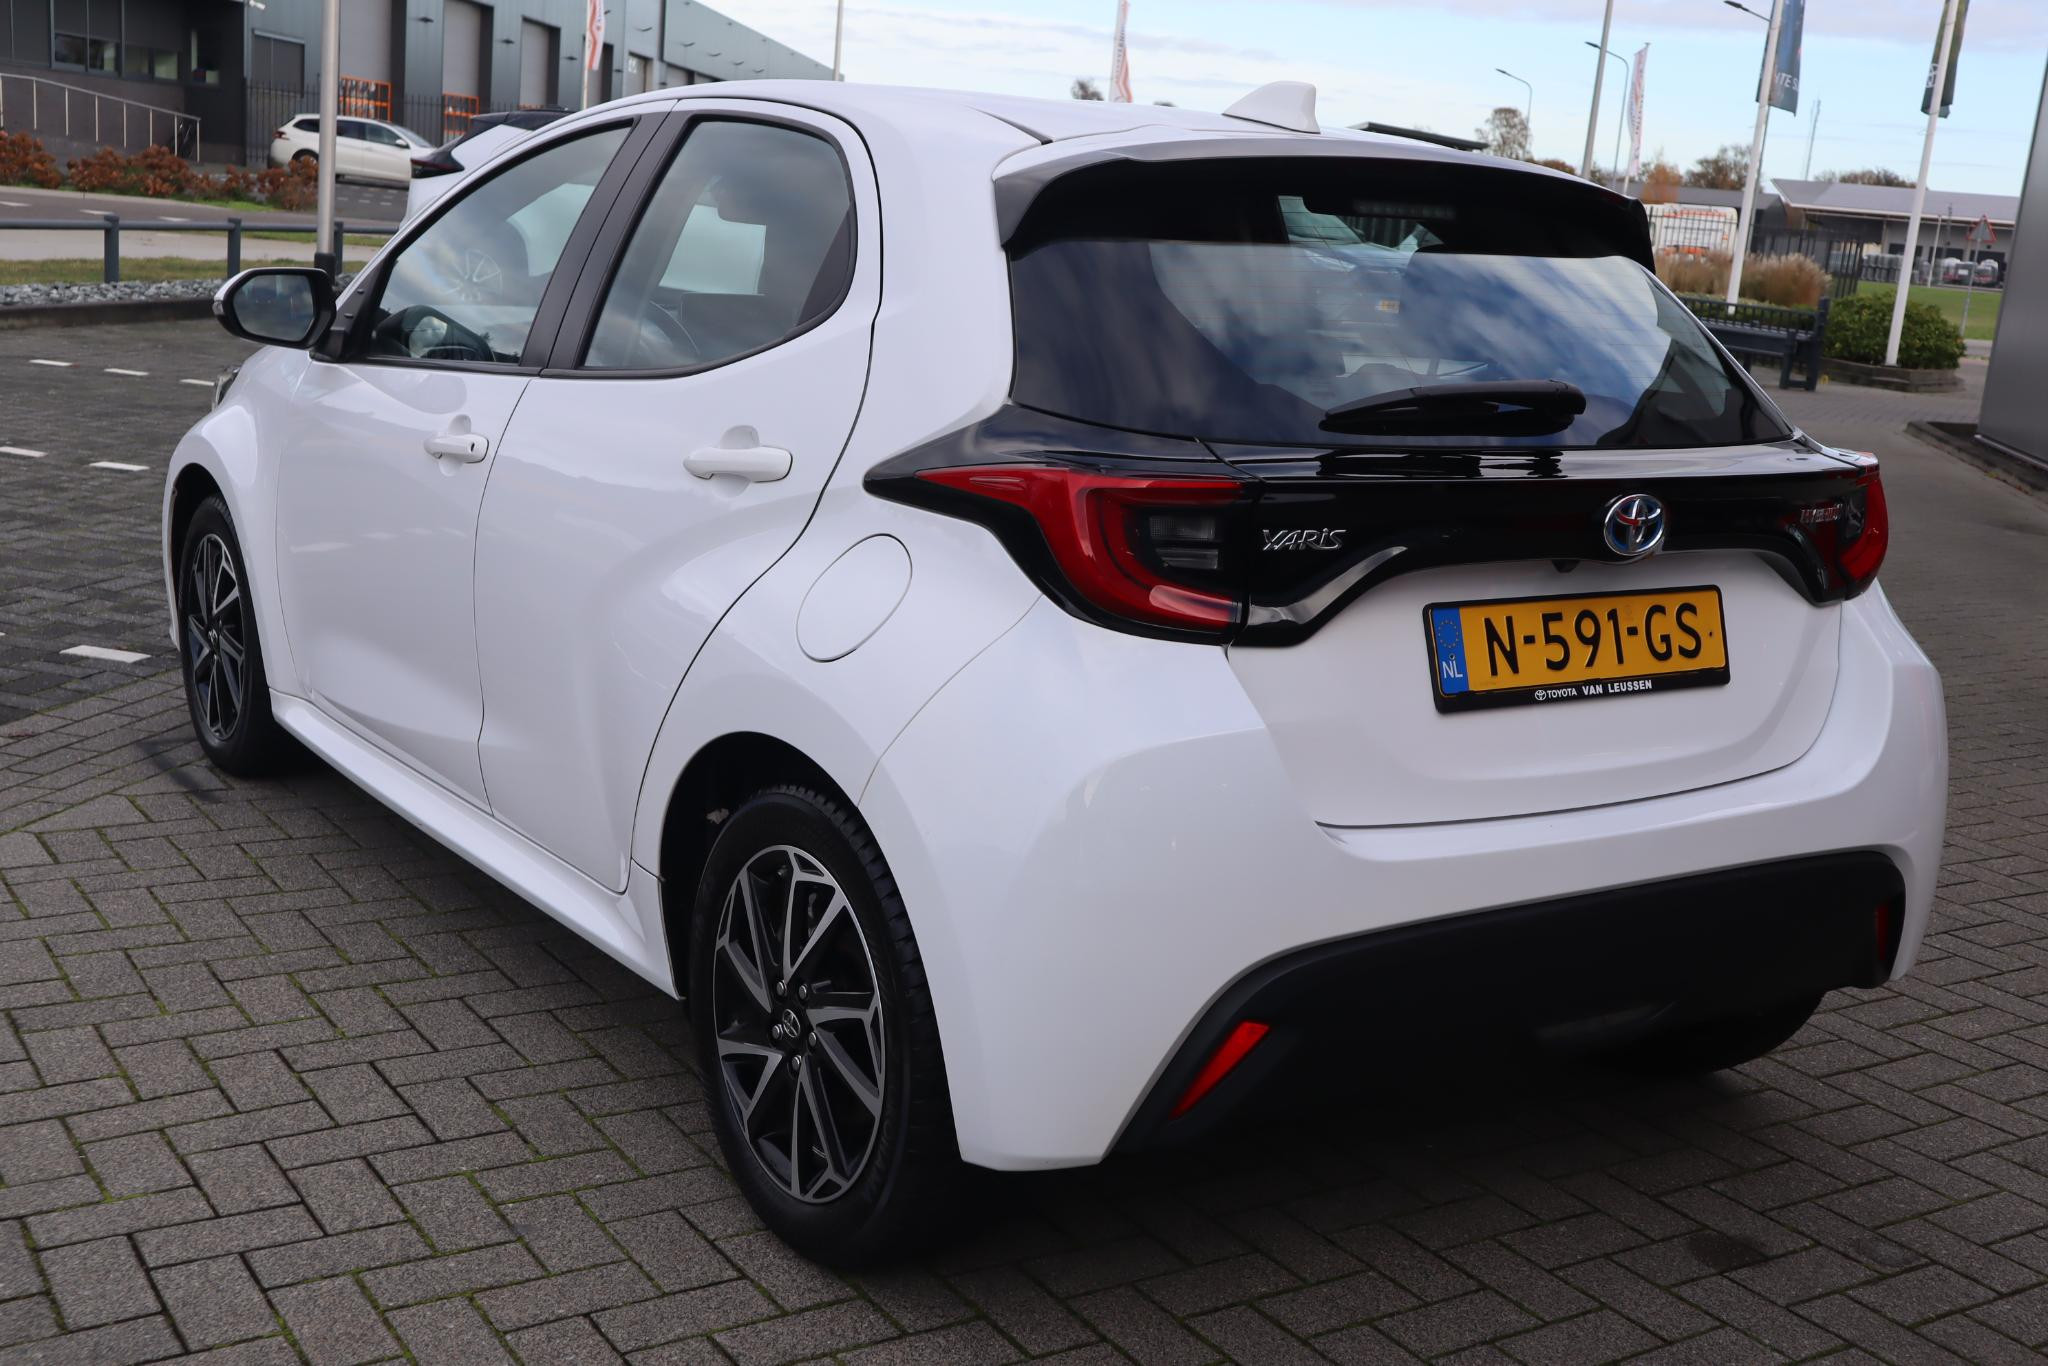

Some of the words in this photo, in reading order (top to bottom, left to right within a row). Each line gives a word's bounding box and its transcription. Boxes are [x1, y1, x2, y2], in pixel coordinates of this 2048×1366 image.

[1484, 602, 1703, 677] N-591-GS
[1442, 659, 1463, 679] NL
[1547, 687, 1578, 699] TOYOTA
[1582, 684, 1603, 696] VAN
[1608, 679, 1653, 693] LEUSSEN
